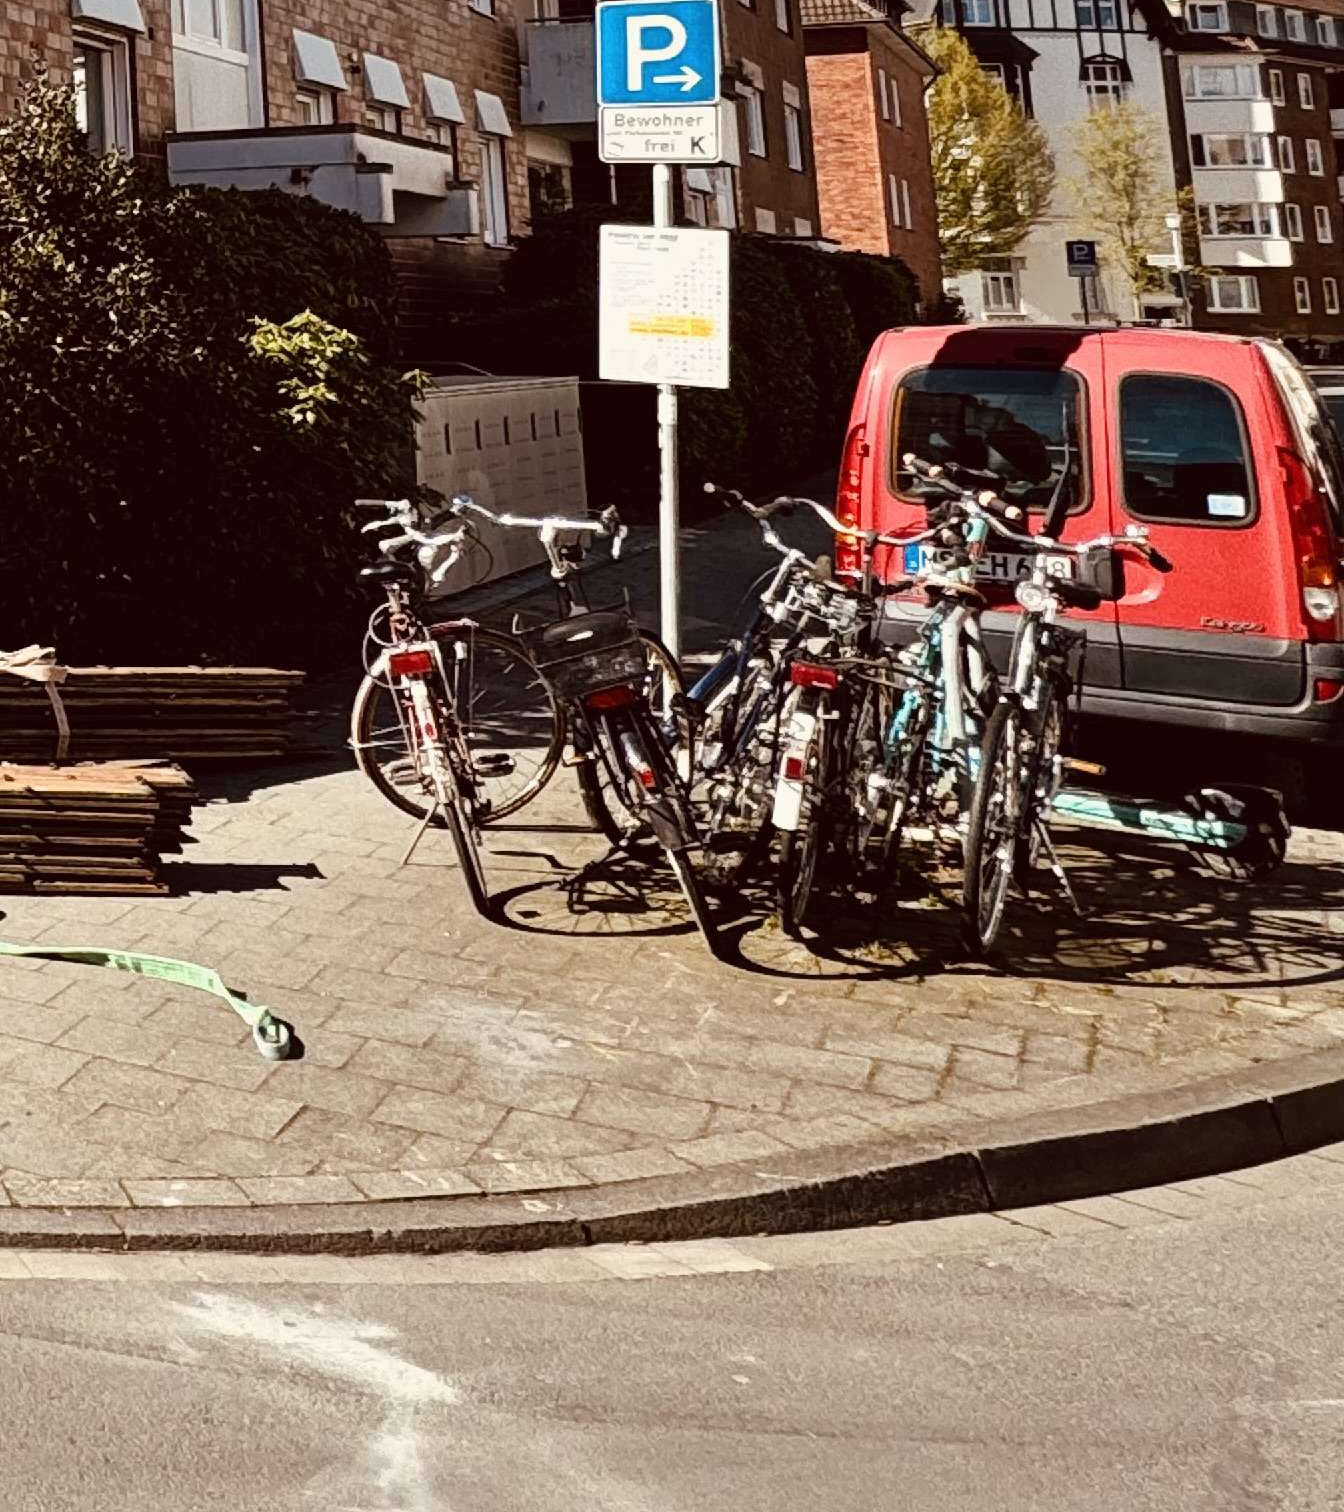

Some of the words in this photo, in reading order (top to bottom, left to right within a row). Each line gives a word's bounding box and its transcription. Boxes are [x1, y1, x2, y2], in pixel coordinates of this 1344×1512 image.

[626, 14, 687, 92] P
[614, 113, 704, 128] Bewohner
[644, 138, 675, 153] frei
[690, 136, 706, 155] K
